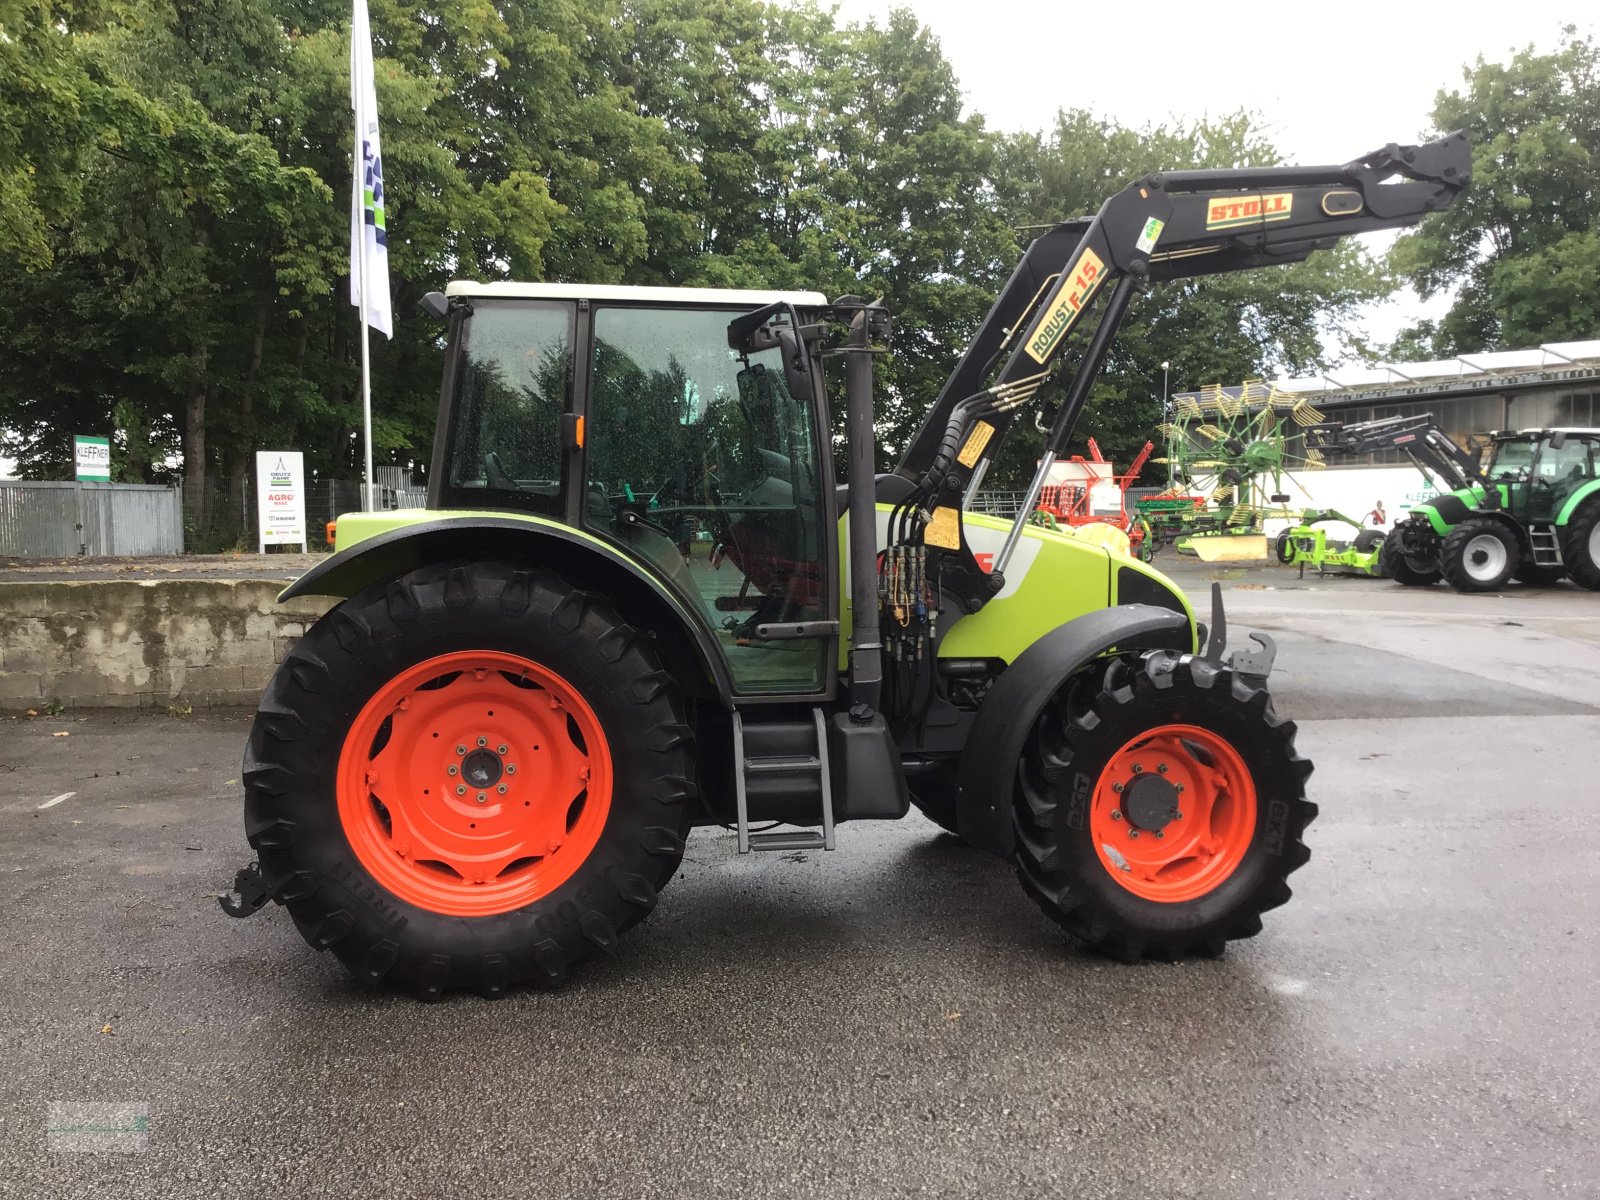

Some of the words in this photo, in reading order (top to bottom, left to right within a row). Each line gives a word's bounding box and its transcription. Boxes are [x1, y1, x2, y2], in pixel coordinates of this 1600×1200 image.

[1210, 197, 1287, 221] STOLL
[1031, 300, 1071, 356] ROBUST
[76, 446, 109, 459] KLEFFNER
[1068, 772, 1090, 830] BKT
[1263, 799, 1290, 856] BKT
